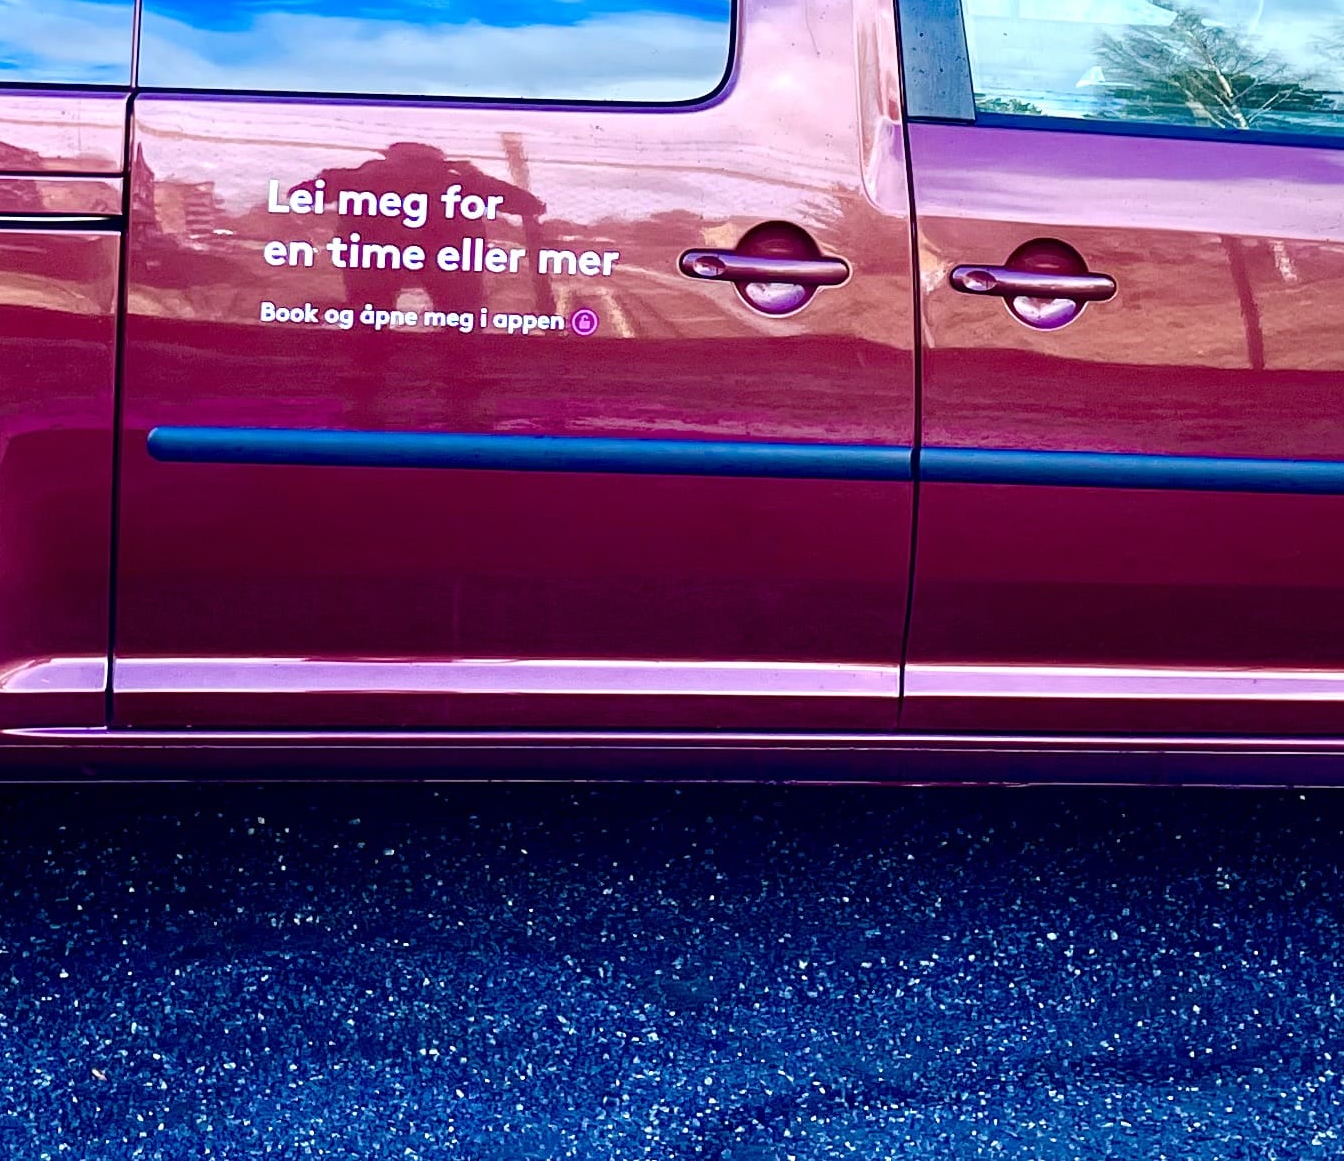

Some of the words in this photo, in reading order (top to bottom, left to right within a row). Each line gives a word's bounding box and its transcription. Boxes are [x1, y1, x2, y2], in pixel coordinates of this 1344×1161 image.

[267, 179, 325, 214] Lei
[338, 191, 428, 228] meg
[441, 184, 504, 220] for
[263, 241, 313, 267] en
[326, 233, 425, 270] time
[437, 237, 527, 273] eller
[538, 250, 620, 276] mer
[260, 301, 319, 324] Book
[324, 309, 354, 330] og
[359, 303, 418, 330] åpne
[424, 311, 474, 333] meg
[479, 307, 488, 328] i
[492, 314, 565, 335] appen
